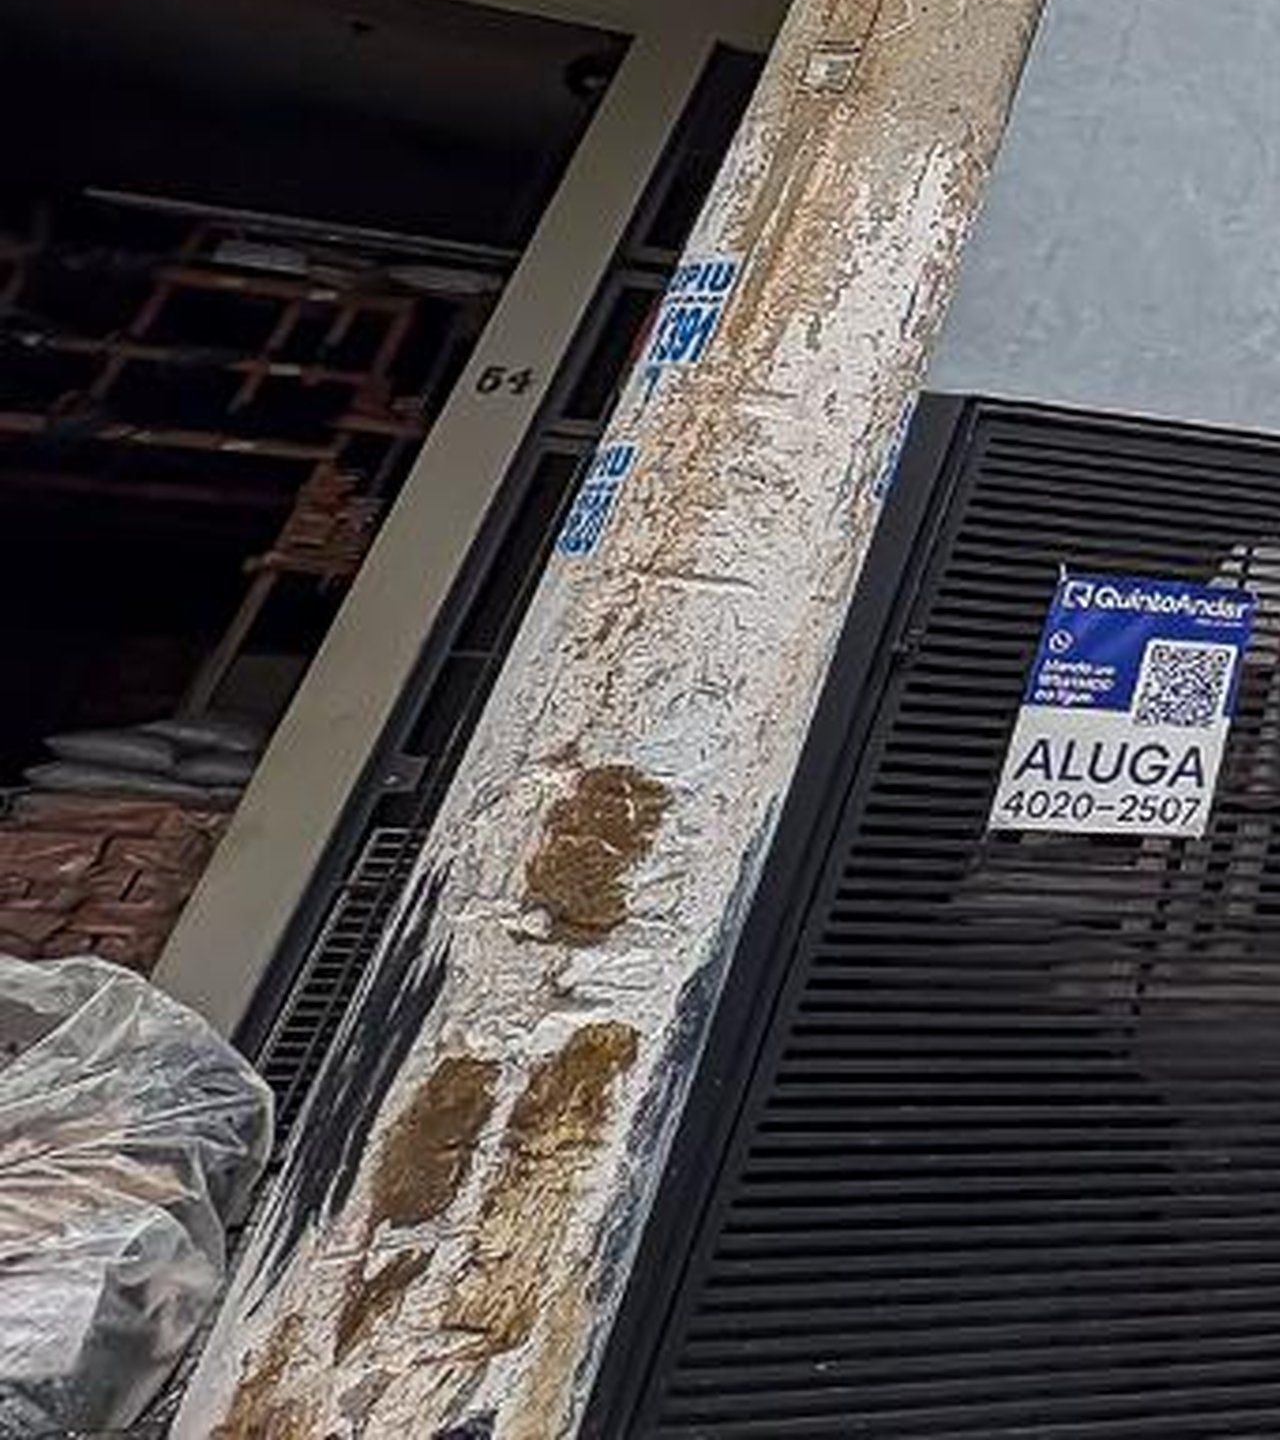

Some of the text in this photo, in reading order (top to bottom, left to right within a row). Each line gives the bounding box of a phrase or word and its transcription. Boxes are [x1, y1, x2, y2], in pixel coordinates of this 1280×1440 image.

[1095, 586, 1249, 618] QuintoAndar
[1013, 738, 1205, 787] ALUGA
[1002, 790, 1200, 826] 4020-2507
